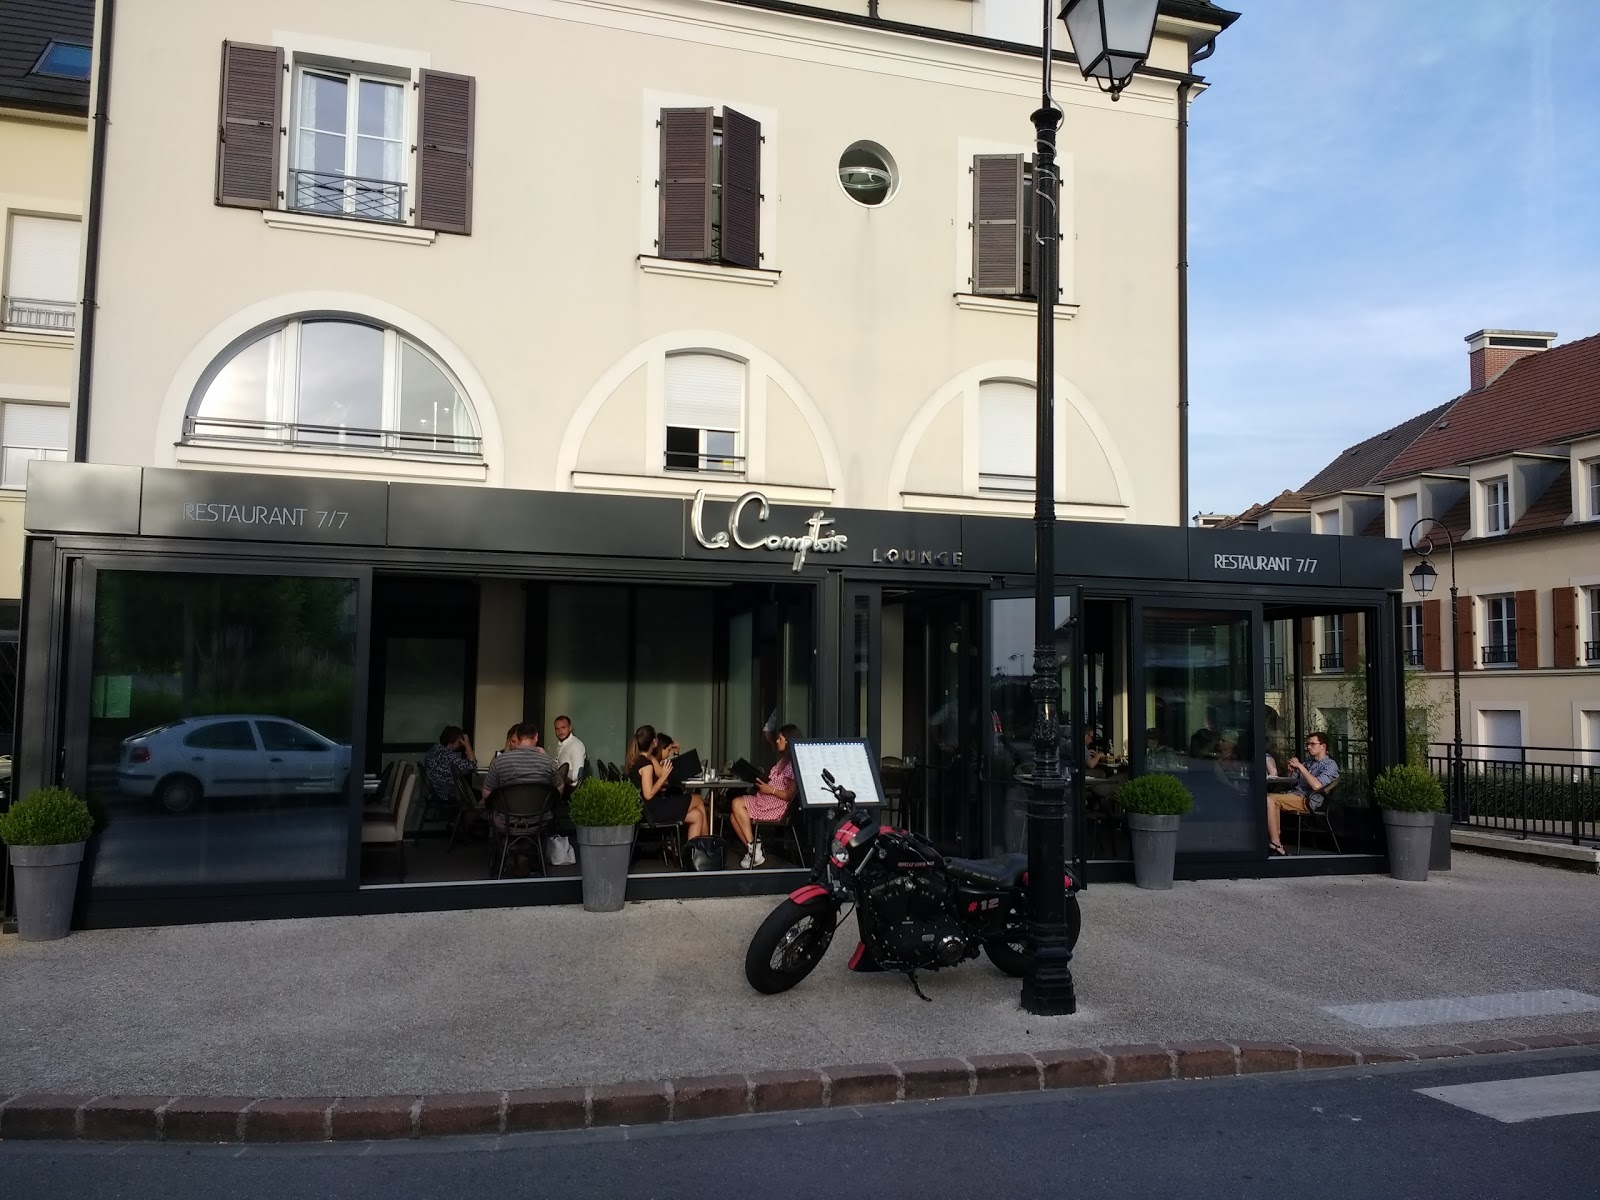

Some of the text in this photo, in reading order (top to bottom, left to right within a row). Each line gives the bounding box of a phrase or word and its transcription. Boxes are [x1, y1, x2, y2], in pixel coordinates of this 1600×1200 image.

[183, 503, 349, 529] RESTAURANT 7/7
[728, 491, 848, 573] Comptoir
[872, 548, 963, 567] LOUNGE
[1214, 553, 1318, 573] RESTAURANT 7/7
